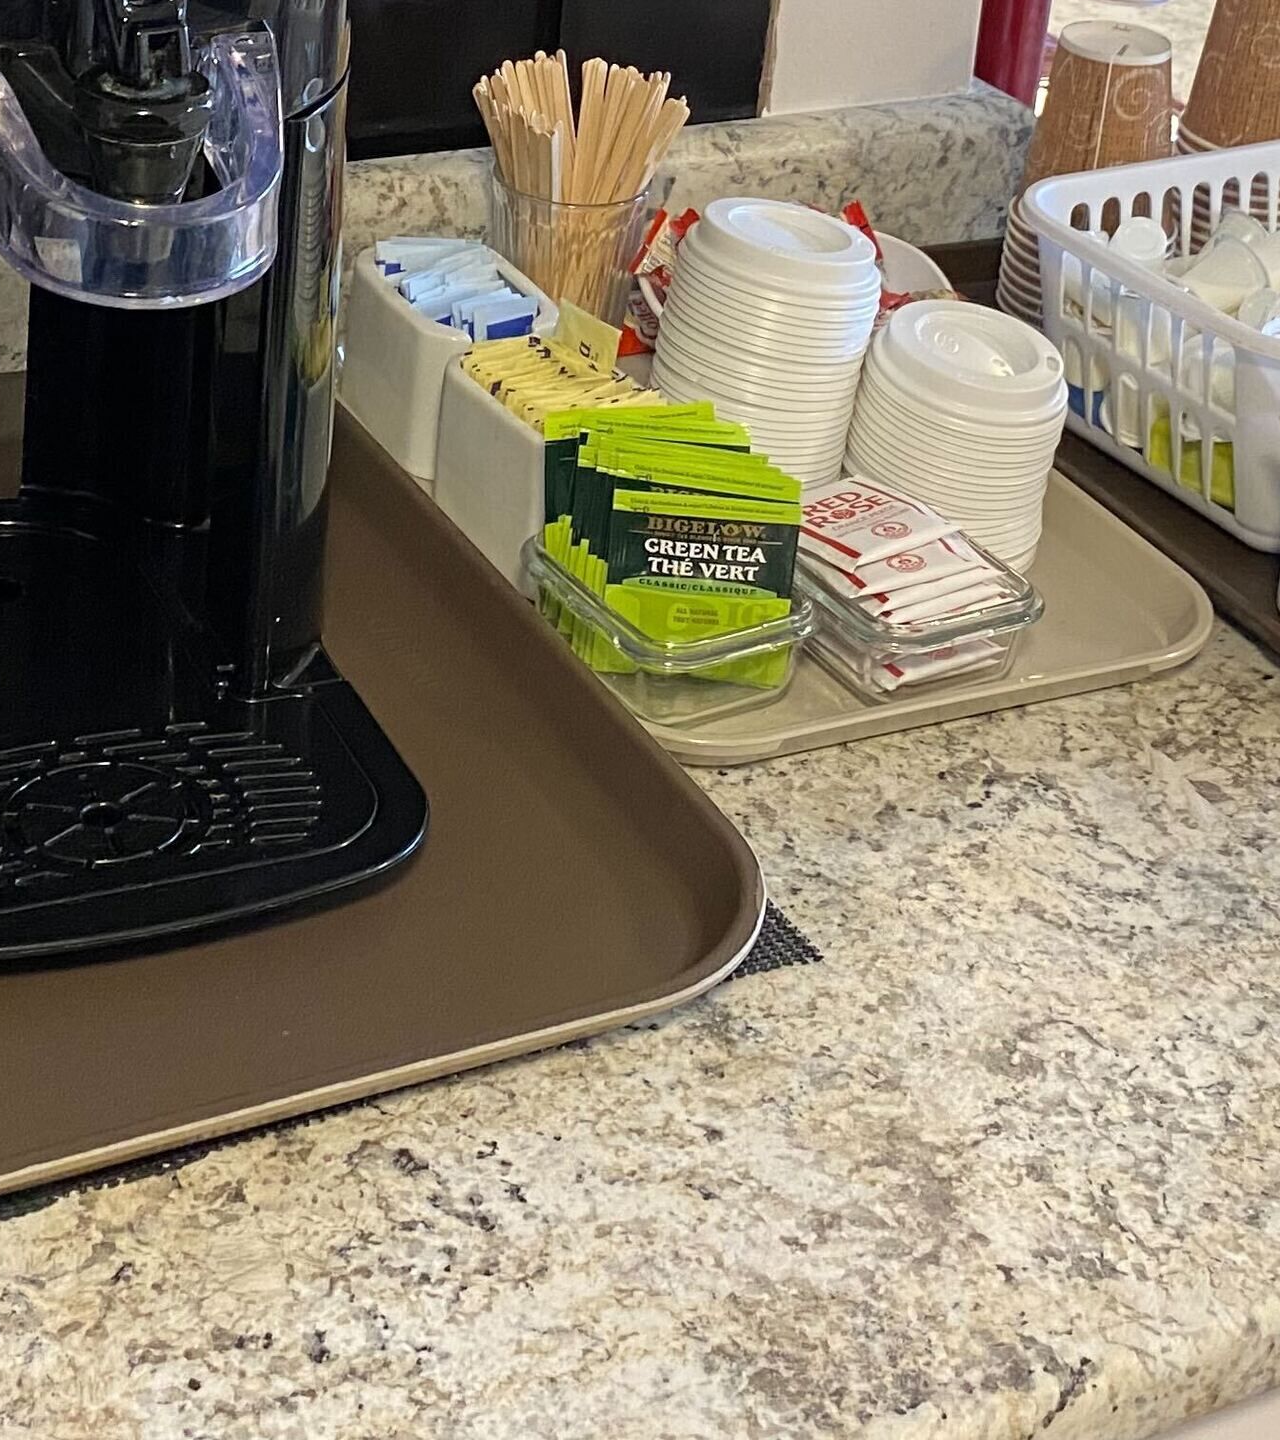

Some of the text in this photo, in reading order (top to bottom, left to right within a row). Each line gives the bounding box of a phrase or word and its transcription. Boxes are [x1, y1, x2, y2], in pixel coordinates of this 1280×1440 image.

[802, 492, 861, 517] RED
[647, 516, 764, 538] BIGELOW
[645, 538, 767, 563] GREEN TEA
[648, 556, 759, 581] THÉ VERT
